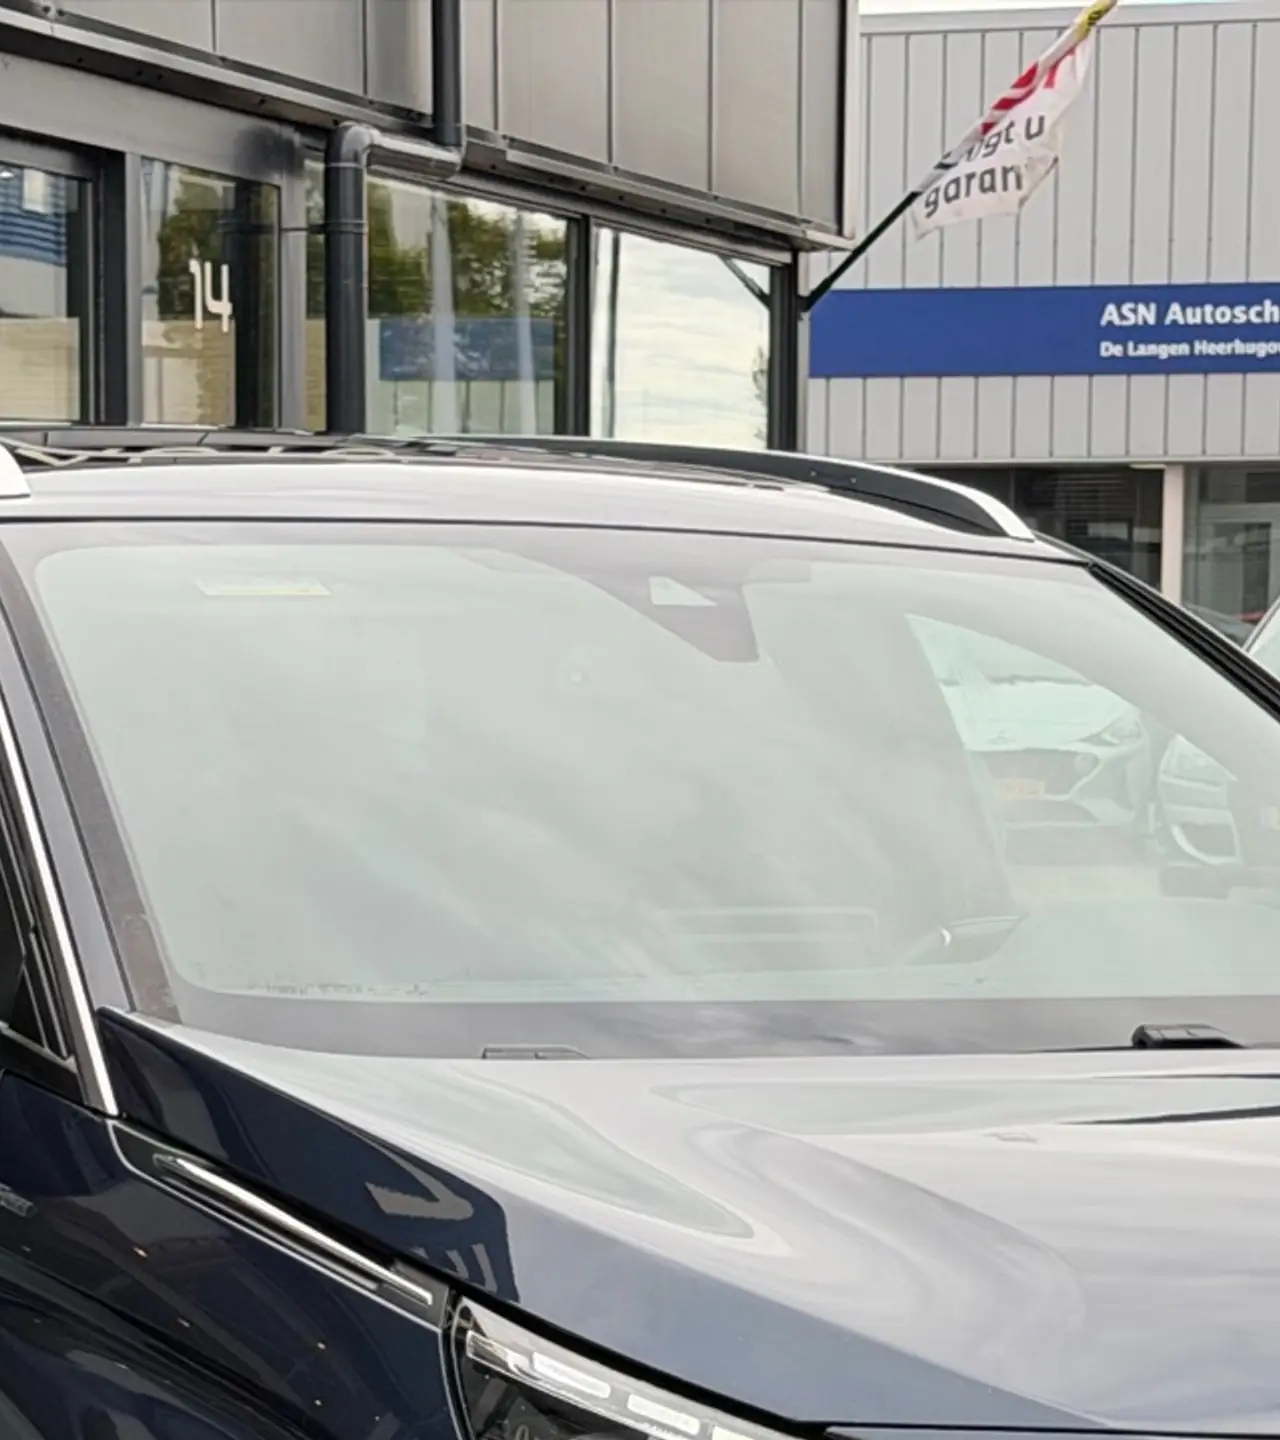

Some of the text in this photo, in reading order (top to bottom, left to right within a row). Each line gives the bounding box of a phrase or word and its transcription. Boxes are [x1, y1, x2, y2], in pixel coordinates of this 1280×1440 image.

[188, 258, 233, 333] 14
[1099, 302, 1157, 326] ASN
[1100, 341, 1123, 358] De
[1127, 340, 1190, 360] Langen
